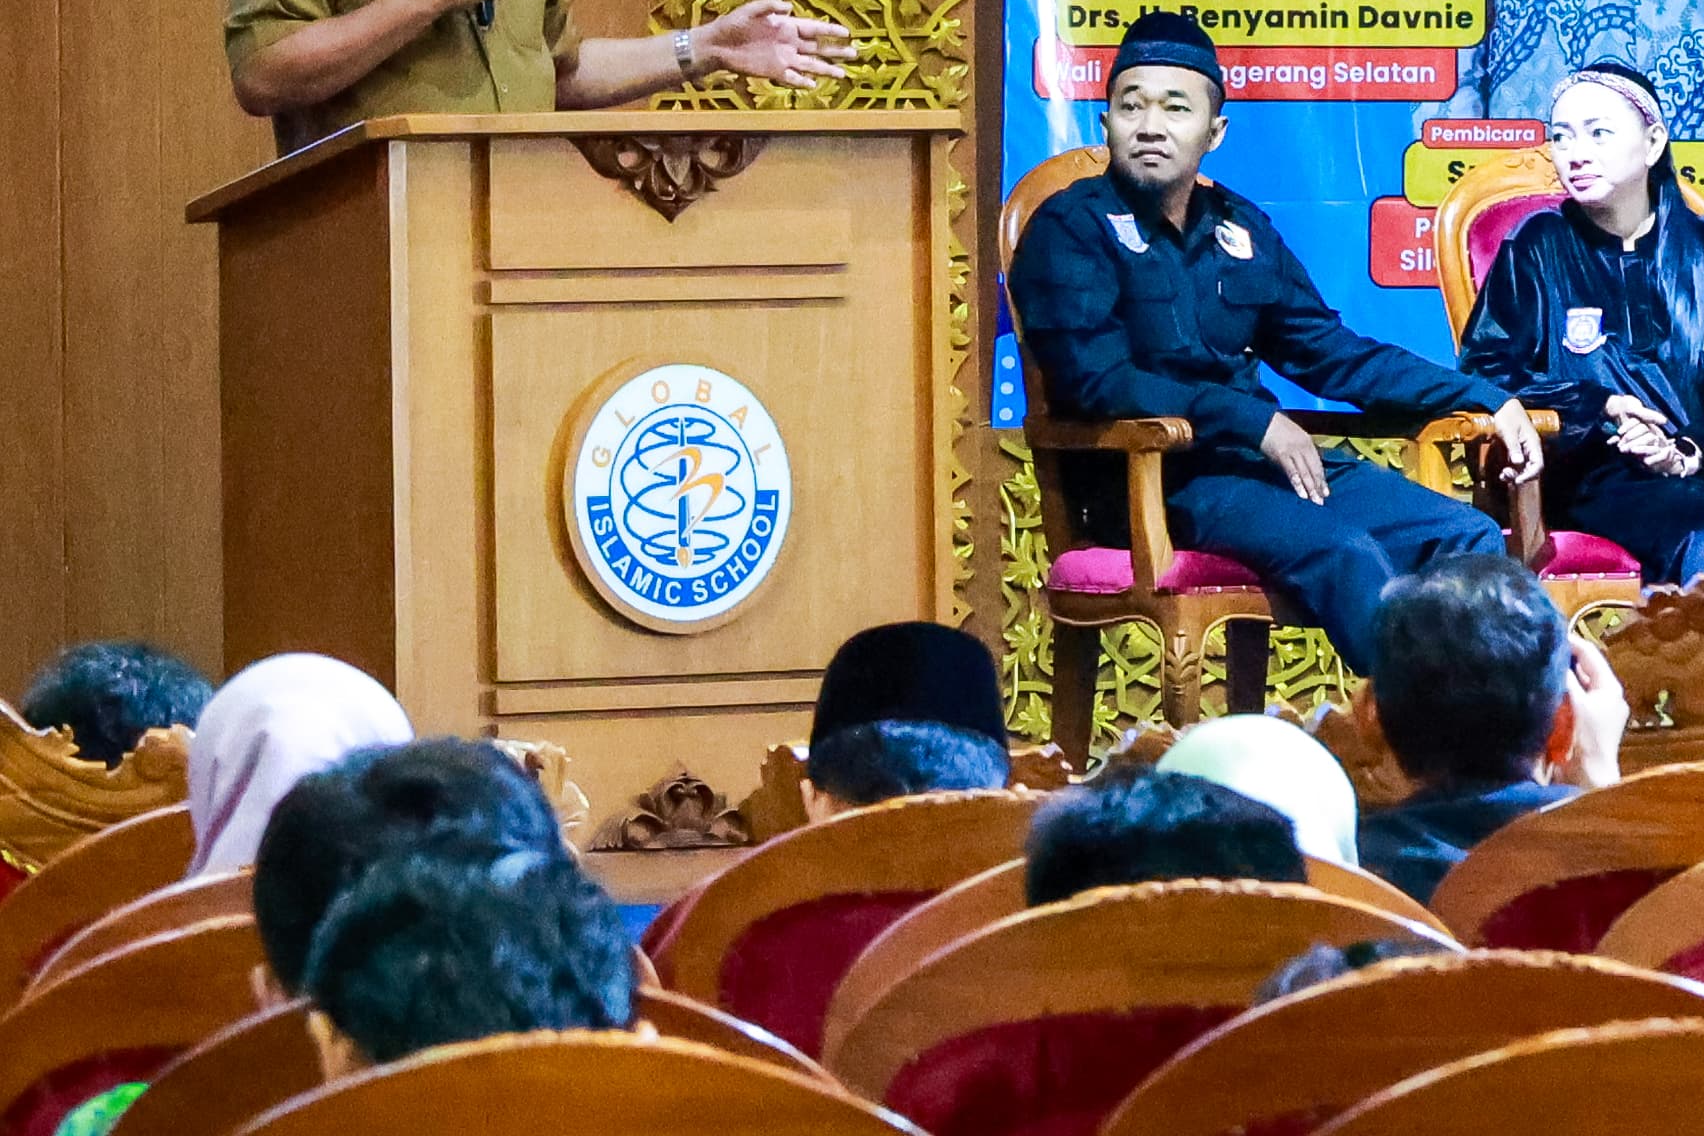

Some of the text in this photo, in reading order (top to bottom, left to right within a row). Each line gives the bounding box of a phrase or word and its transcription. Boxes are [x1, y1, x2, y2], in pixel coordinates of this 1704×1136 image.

[1068, 5, 1130, 29] Drs.
[1358, 4, 1473, 29] Davnie
[1221, 65, 1326, 89] ngerang
[1334, 62, 1436, 85] Selatan
[1430, 126, 1536, 142] Pembicara
[592, 378, 772, 468] GLOBAL
[590, 494, 776, 604] ISLAMIC SCHOOL
